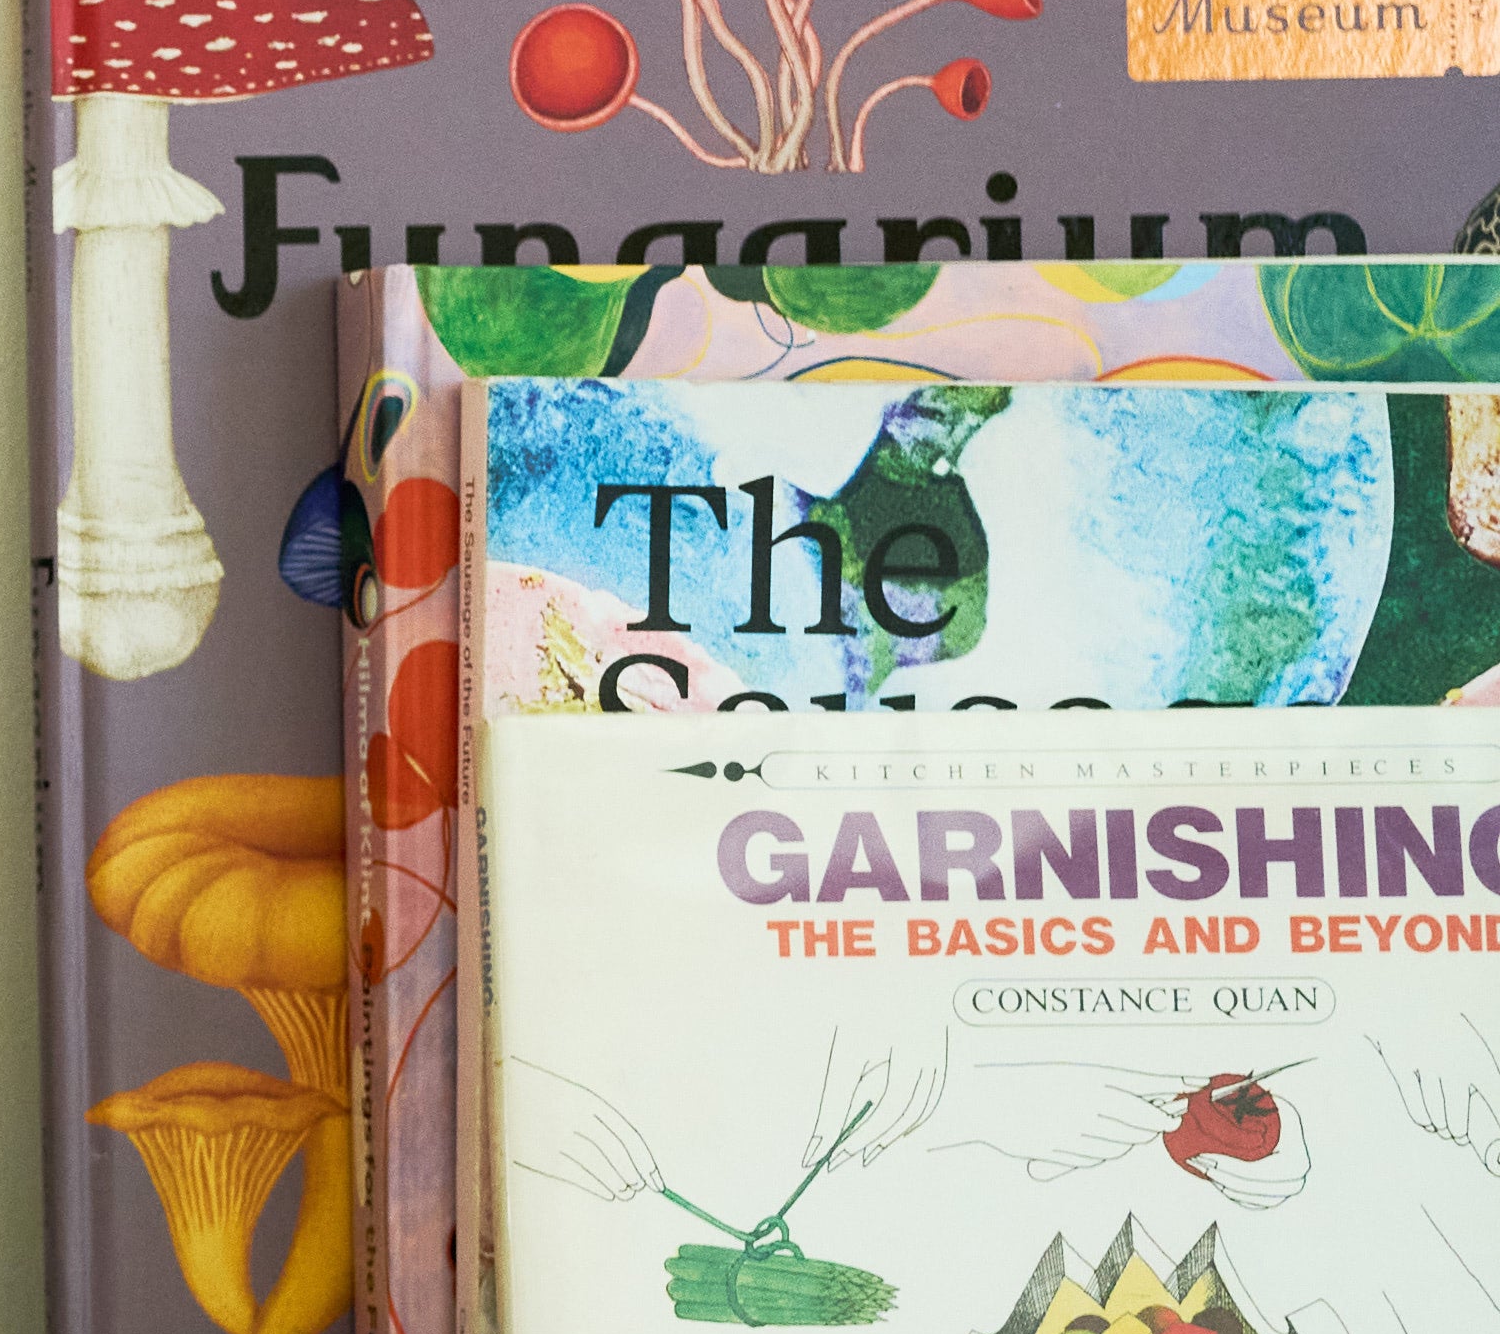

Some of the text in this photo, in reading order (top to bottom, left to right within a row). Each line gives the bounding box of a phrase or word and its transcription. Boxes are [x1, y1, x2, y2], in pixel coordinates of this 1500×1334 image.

[593, 474, 960, 637] The
[461, 477, 476, 806] The Sausage of the Future
[815, 756, 1459, 783] KITCHEN MASTERPIECES
[766, 914, 1500, 959] THE BASICS AND BEYOND
[971, 985, 1319, 1017] CONSTANCE QUAN
[358, 943, 378, 1142] Paintings
[365, 1225, 377, 1292] the
